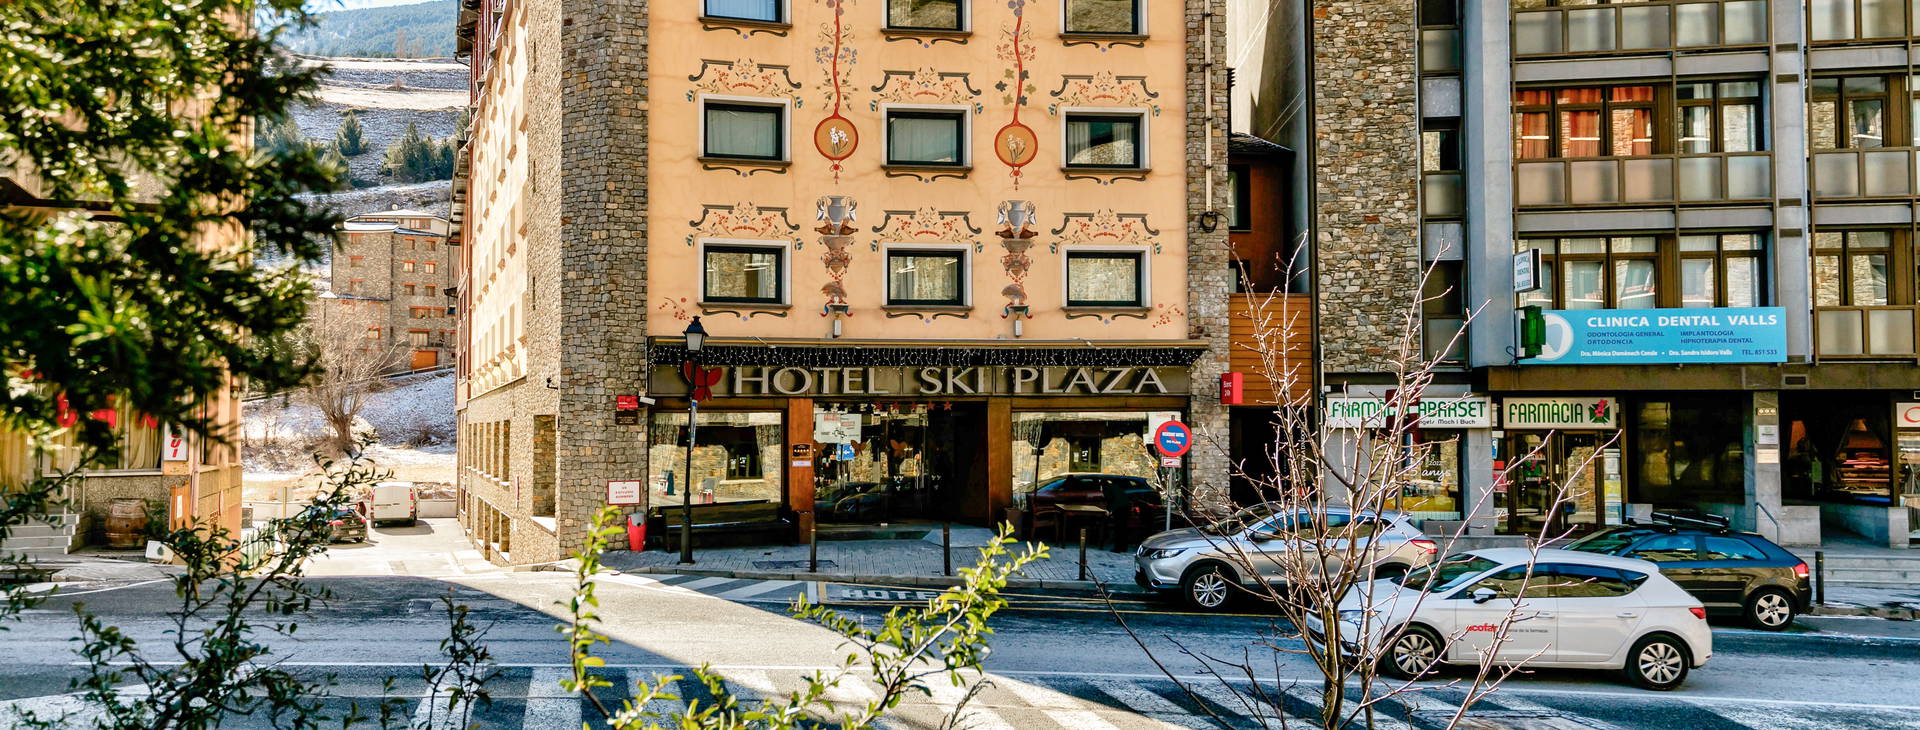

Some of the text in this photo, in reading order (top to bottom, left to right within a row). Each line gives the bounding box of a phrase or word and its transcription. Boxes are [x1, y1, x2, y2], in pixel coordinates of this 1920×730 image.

[1587, 314, 1777, 328] CLINICA DENTAL VALLS
[734, 366, 1168, 395] HOTEL SKI PLAZA
[1508, 399, 1584, 423] FARMÀCIA
[1421, 468, 1451, 481] anys
